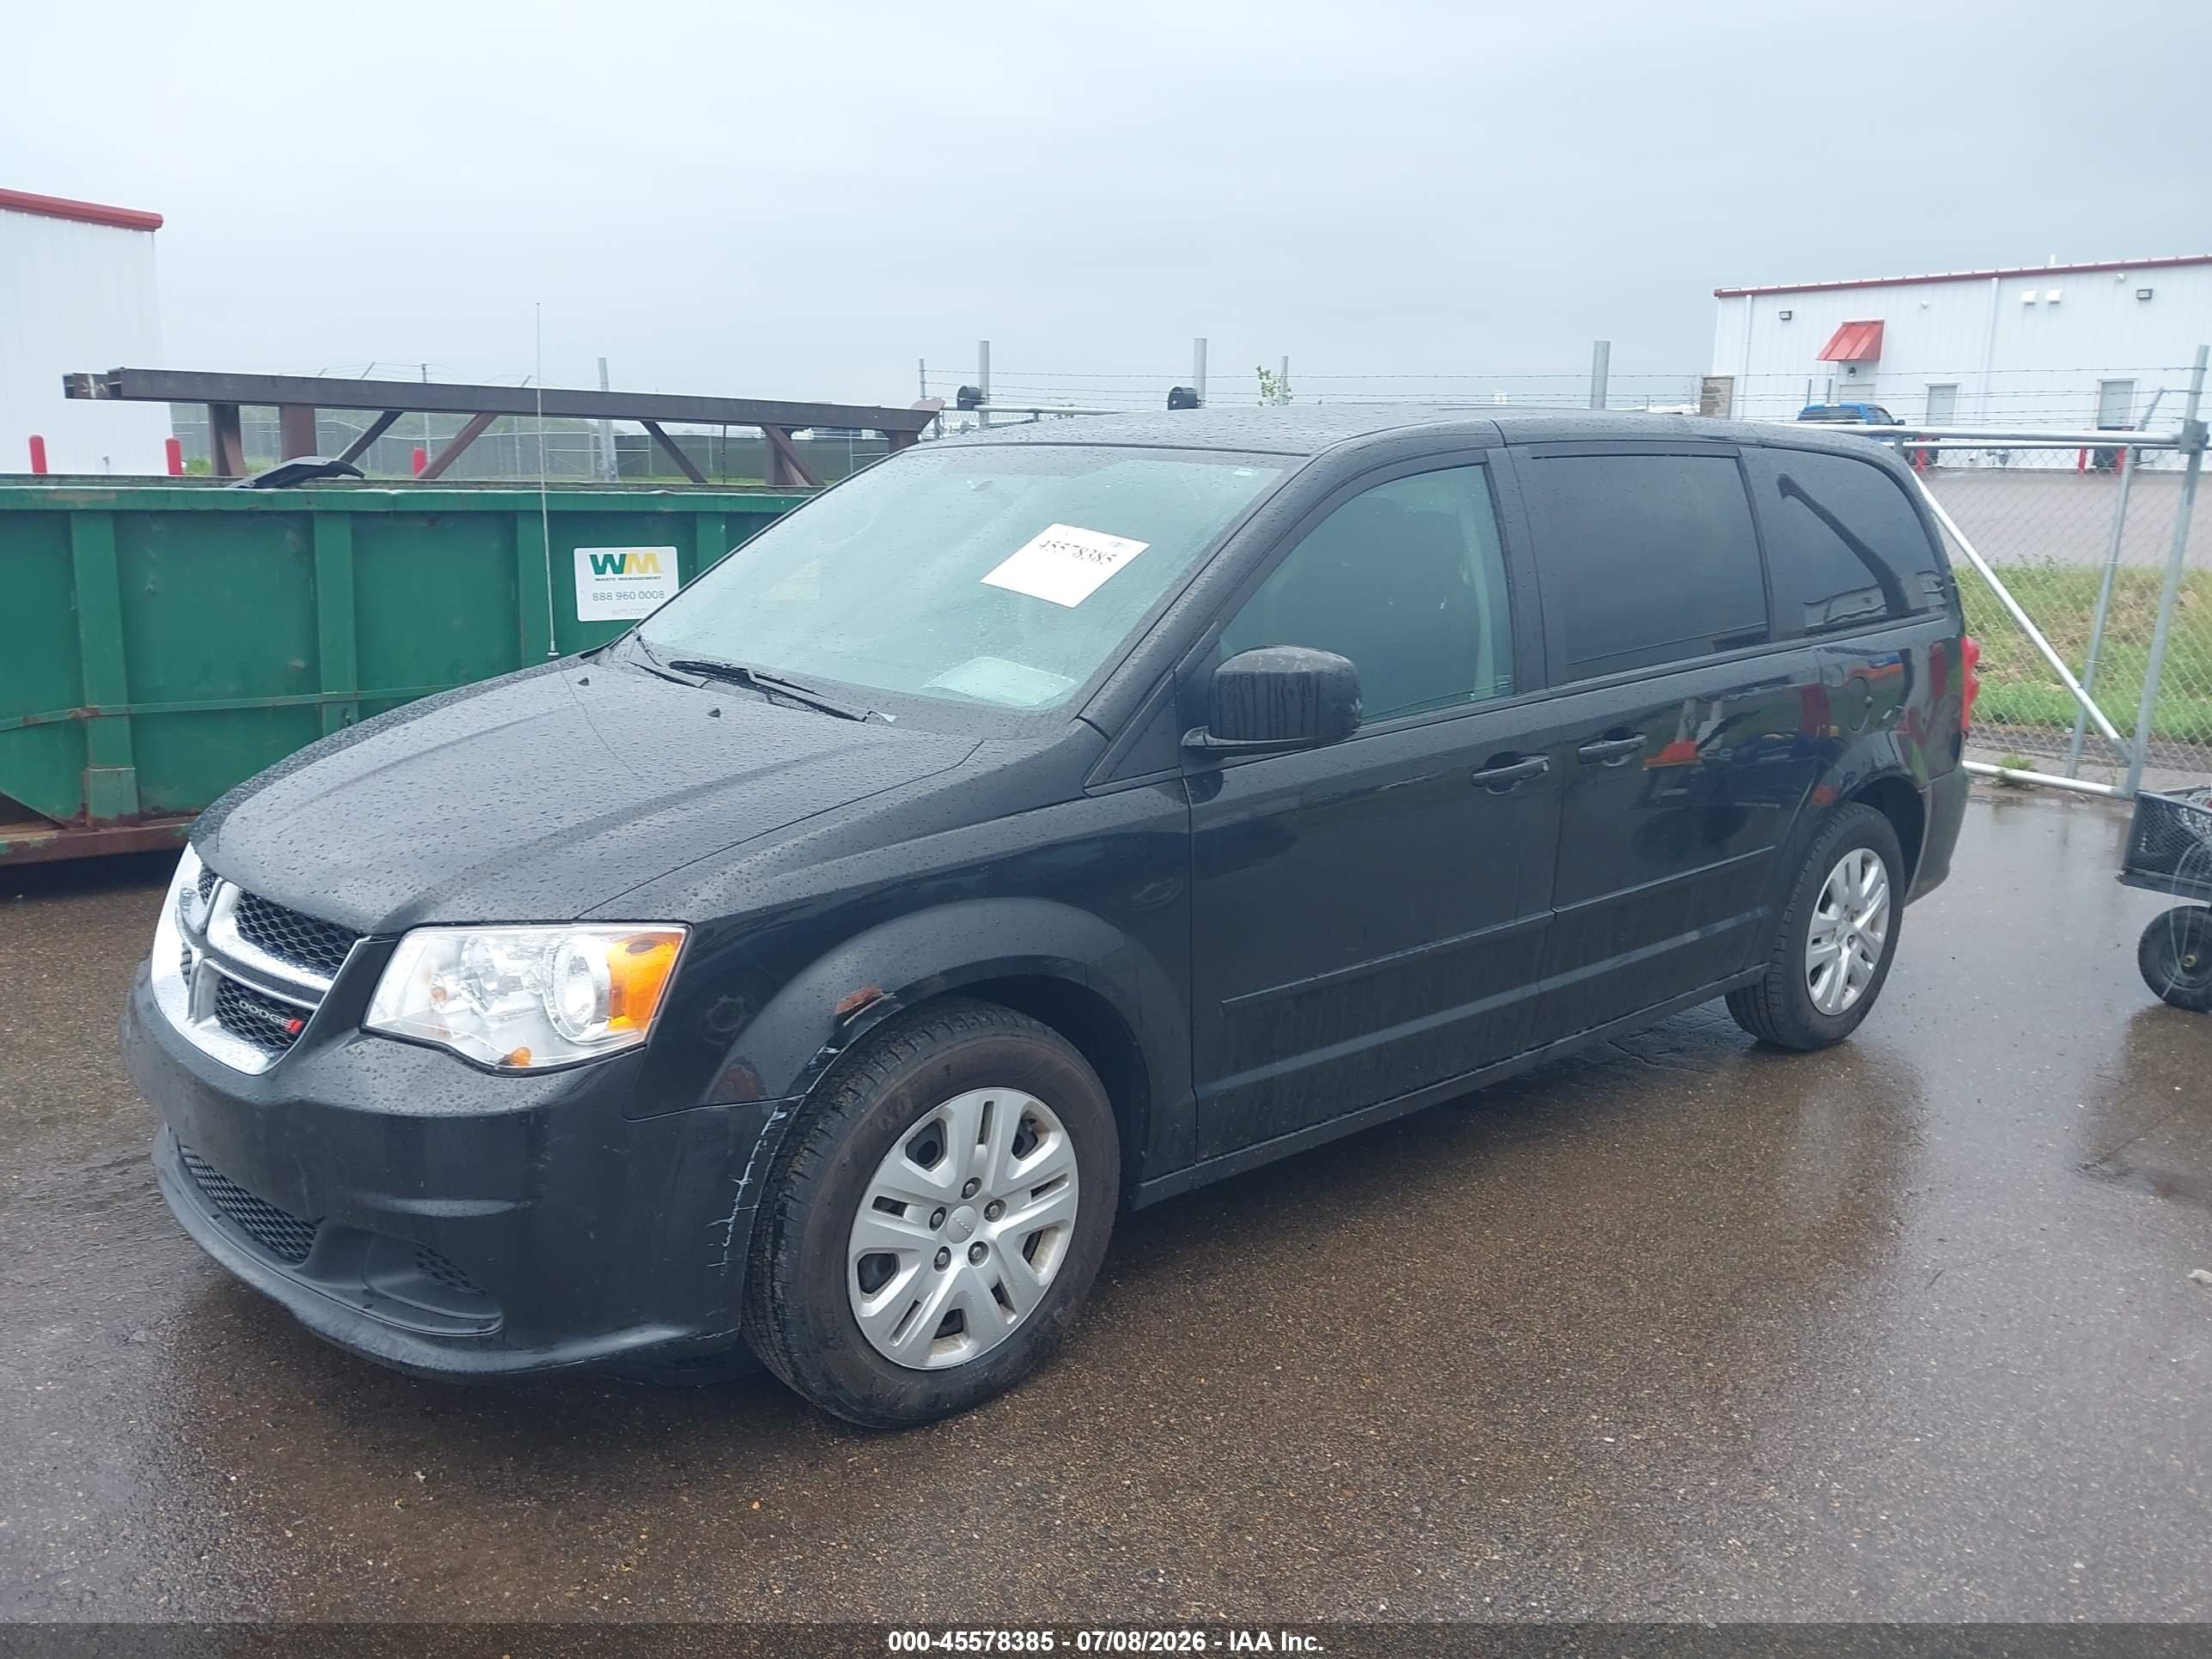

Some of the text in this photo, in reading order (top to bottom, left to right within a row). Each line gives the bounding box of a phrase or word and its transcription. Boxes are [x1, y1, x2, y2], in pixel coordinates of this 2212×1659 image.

[589, 553, 660, 575] WM
[592, 590, 665, 601] 888 960 0008
[239, 1000, 292, 1029] DODGE
